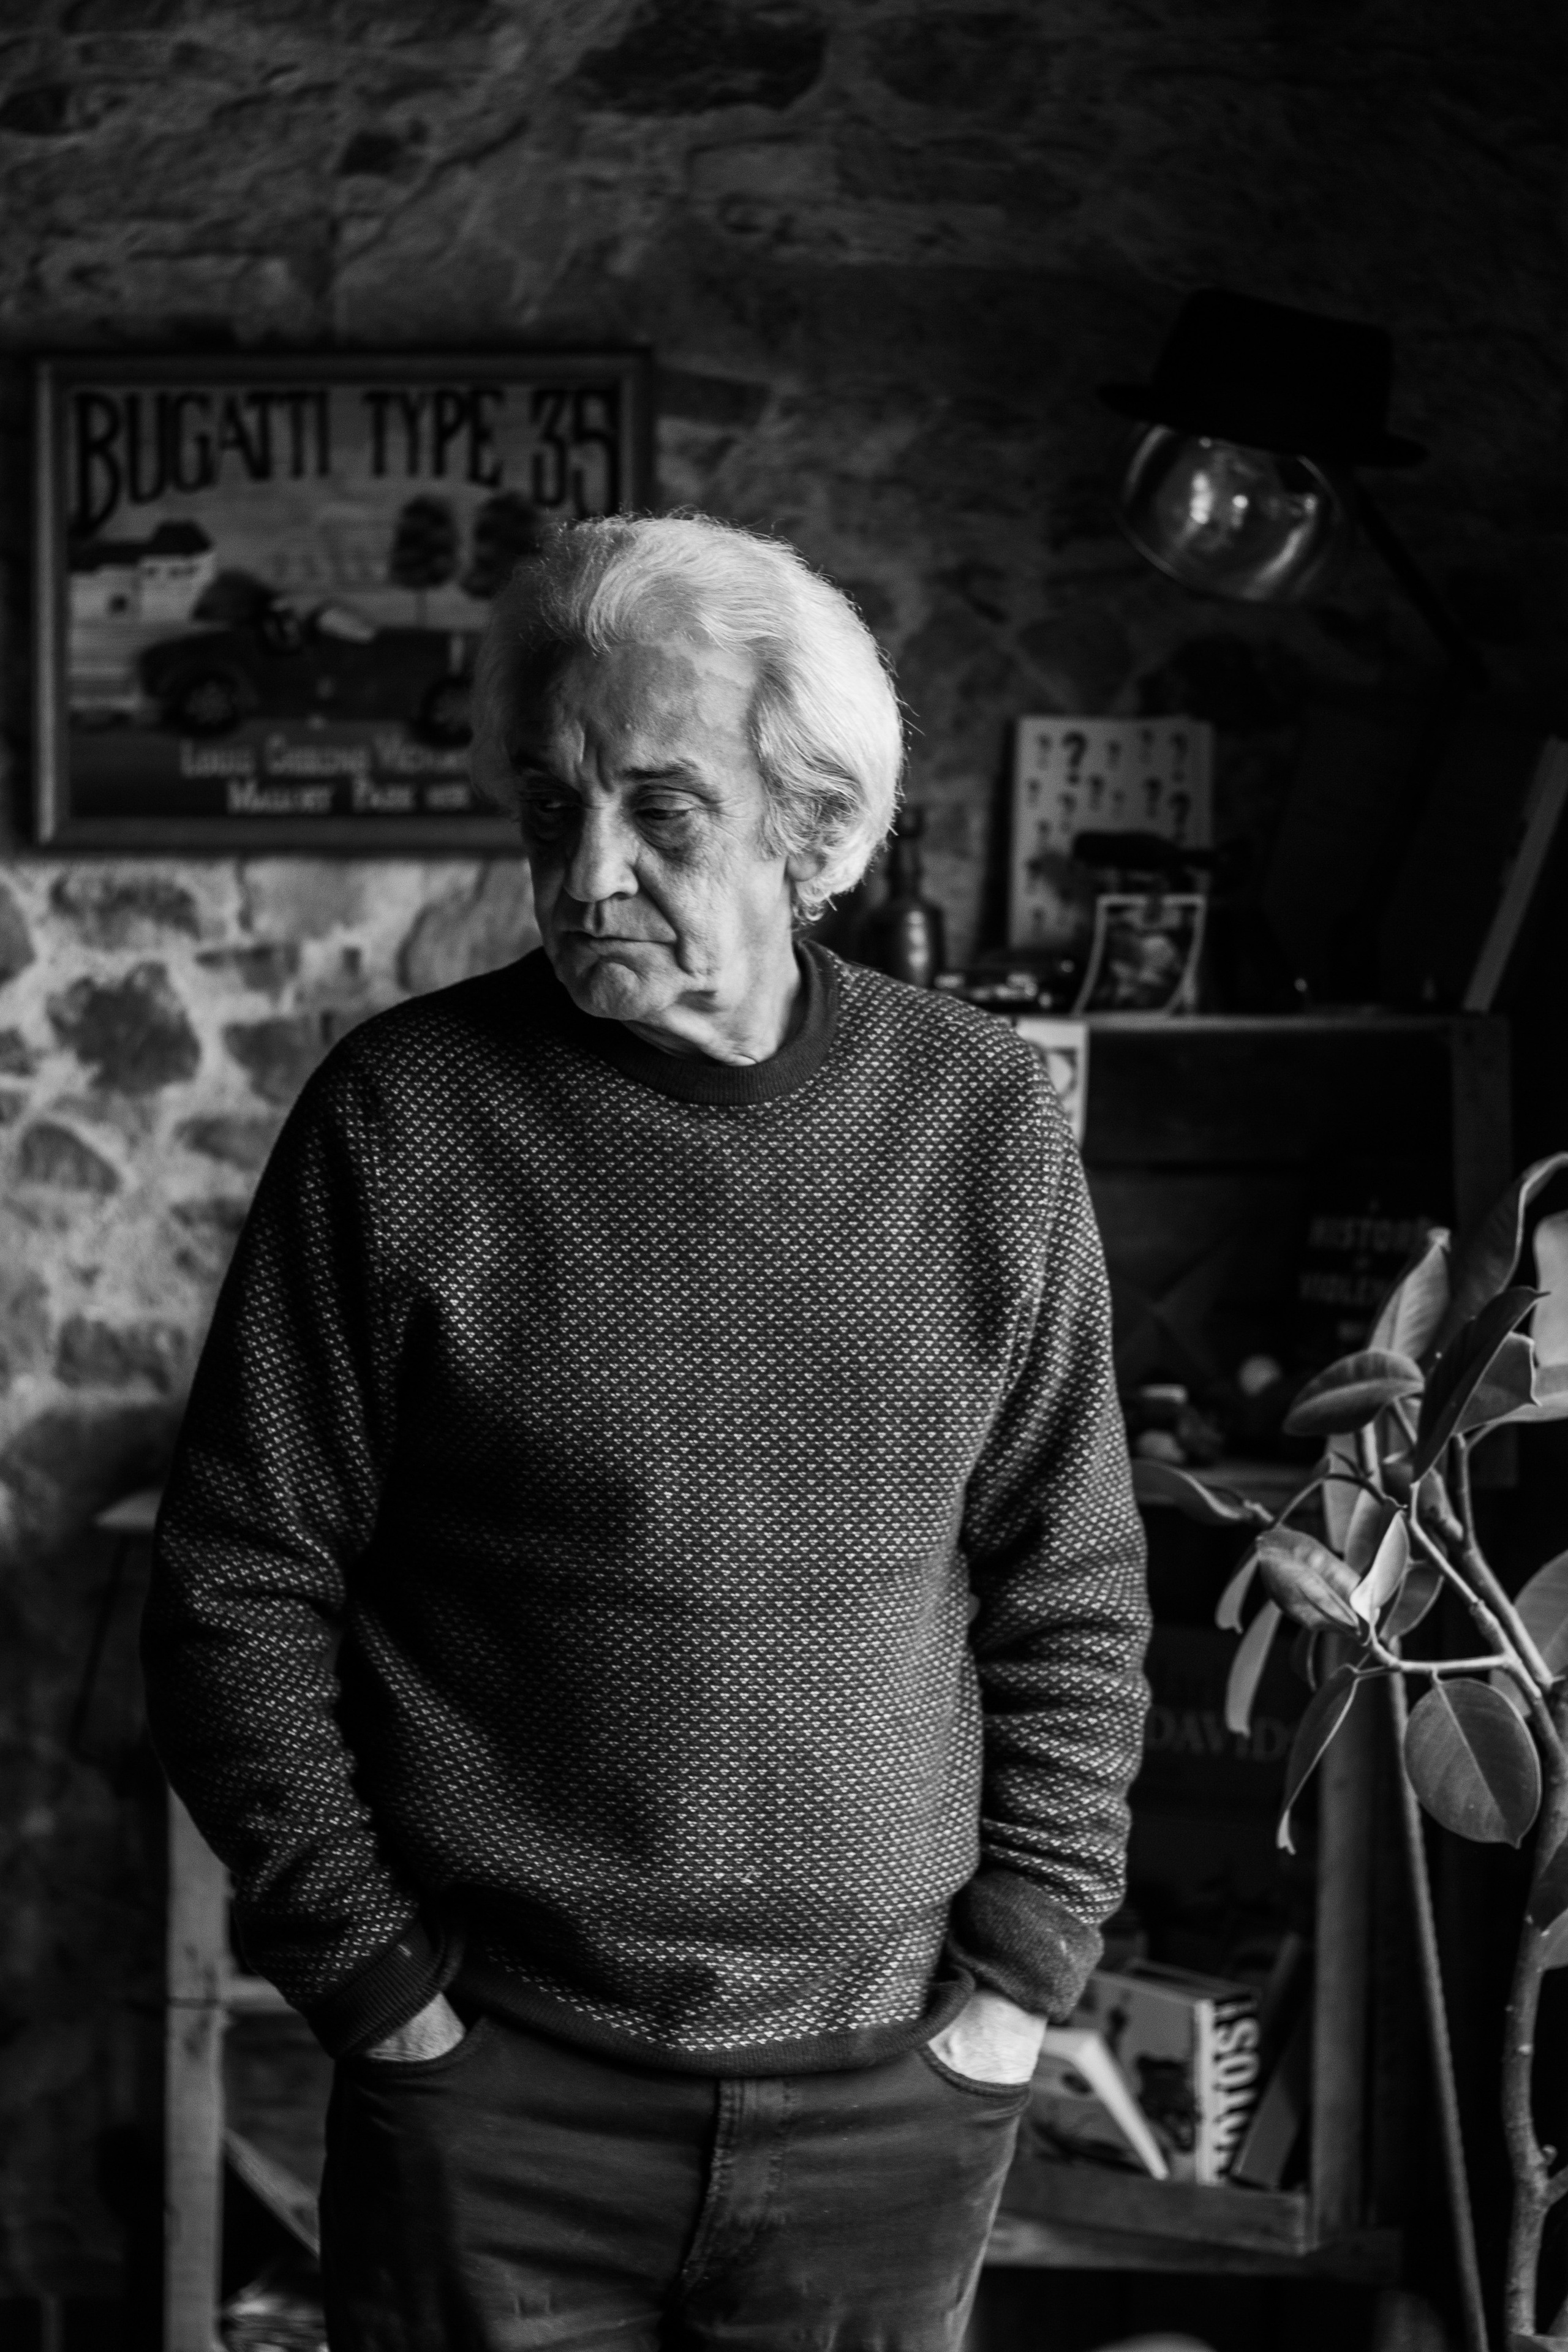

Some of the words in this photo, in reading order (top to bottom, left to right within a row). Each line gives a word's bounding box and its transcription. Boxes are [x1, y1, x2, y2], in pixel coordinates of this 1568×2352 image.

[69, 390, 328, 538] BUGATTI
[364, 390, 505, 487] TYPE
[533, 390, 618, 519] 35
